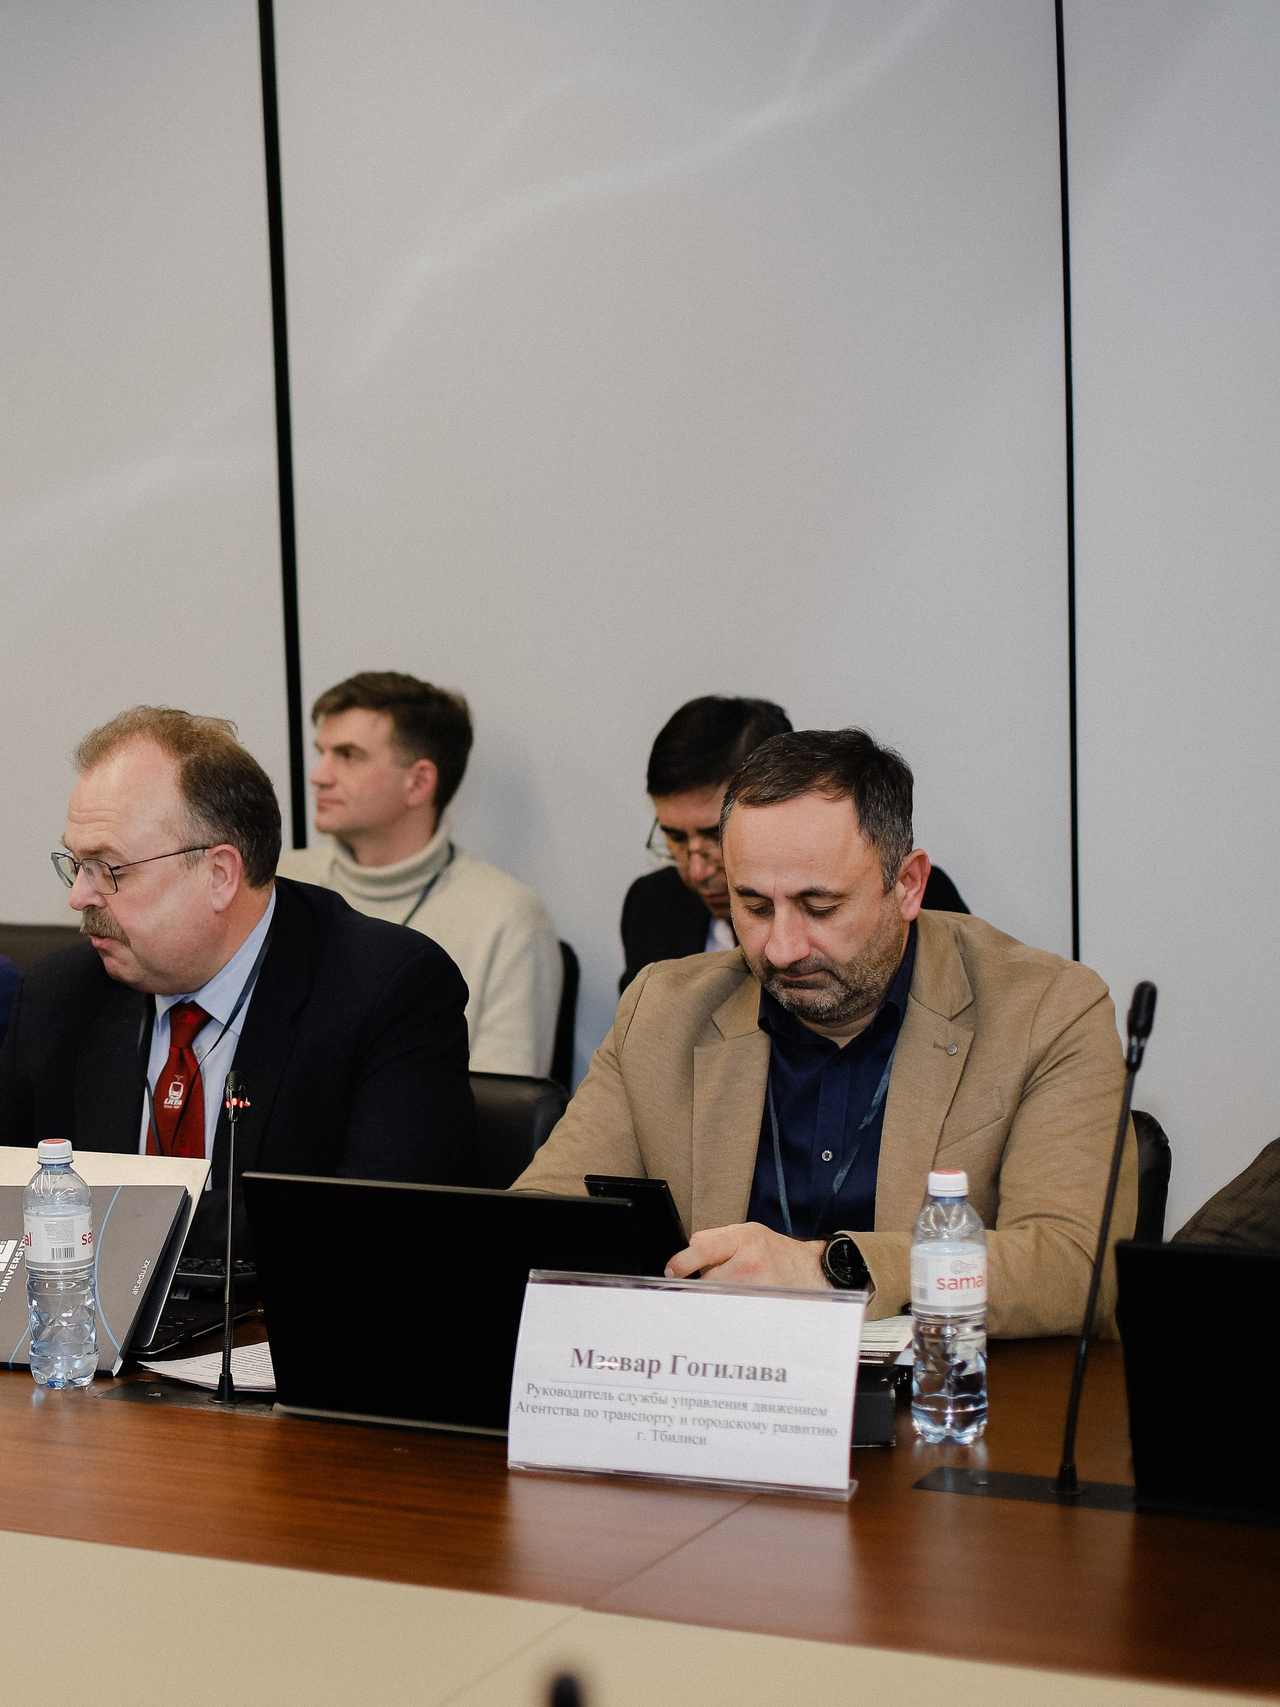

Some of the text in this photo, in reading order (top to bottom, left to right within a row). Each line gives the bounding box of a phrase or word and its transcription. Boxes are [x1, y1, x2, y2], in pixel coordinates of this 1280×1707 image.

[131, 1259, 151, 1296] alt.edu.kz
[570, 1347, 789, 1384] Мзевар Гогилава
[525, 1382, 829, 1418] Руководитель службы управления движением
[514, 1400, 839, 1438] Агентства по транспорту и городскому развитию
[635, 1428, 708, 1446] г. Тбилиси
